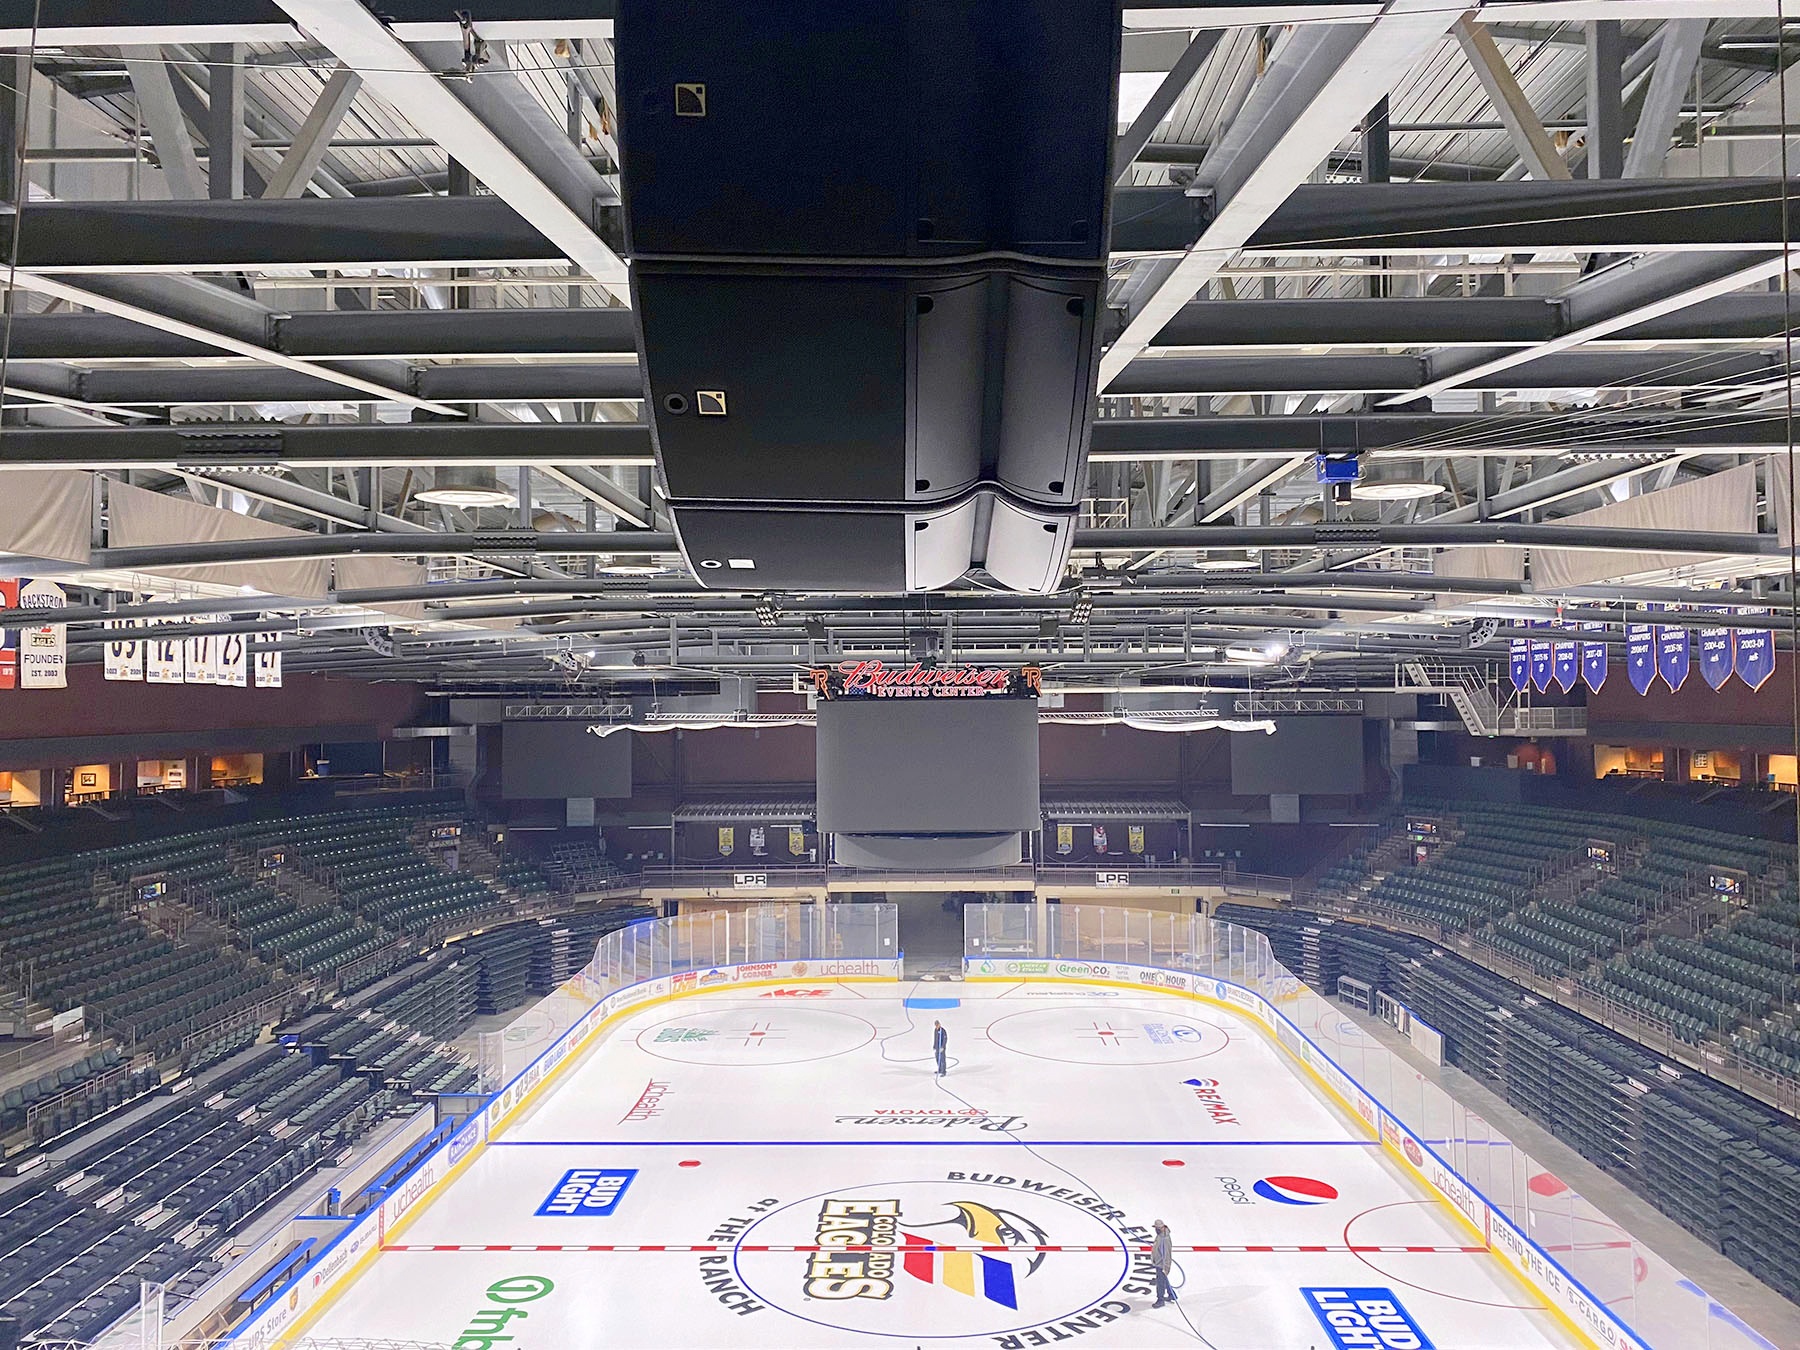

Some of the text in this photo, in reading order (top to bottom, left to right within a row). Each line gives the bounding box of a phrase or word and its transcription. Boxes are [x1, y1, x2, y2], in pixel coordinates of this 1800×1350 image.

[24, 654, 63, 664] FOUNDER
[838, 660, 1010, 689] Budweiser
[877, 686, 985, 697] EVENTS CENTER
[734, 875, 766, 884] LPR
[1096, 874, 1128, 882] LPR
[732, 963, 777, 981] JOHNSON'S
[820, 960, 879, 975] uchealth
[1059, 964, 1090, 974] Green
[1140, 971, 1155, 981] ONE
[1165, 975, 1186, 987] HOUR
[1193, 1088, 1241, 1125] RE/MAX
[391, 1162, 436, 1220] uchealth
[546, 1171, 601, 1214] LIGHT
[582, 1176, 628, 1208] BUD
[947, 1171, 1126, 1221] BUDWEISER
[1214, 1176, 1256, 1205] pepsi
[1432, 1165, 1477, 1222] uchealth
[706, 1217, 755, 1243] THE
[867, 1215, 898, 1280] COLOADO
[1492, 1217, 1524, 1257] DEFEND
[1525, 1250, 1543, 1276] THE
[1545, 1269, 1561, 1294] ICE
[699, 1254, 766, 1316] RANCH
[266, 1308, 287, 1335] Store
[992, 1300, 1131, 1350] CENTER
[1355, 1299, 1422, 1350] BUD
[1568, 1290, 1615, 1344] S-CARGO
